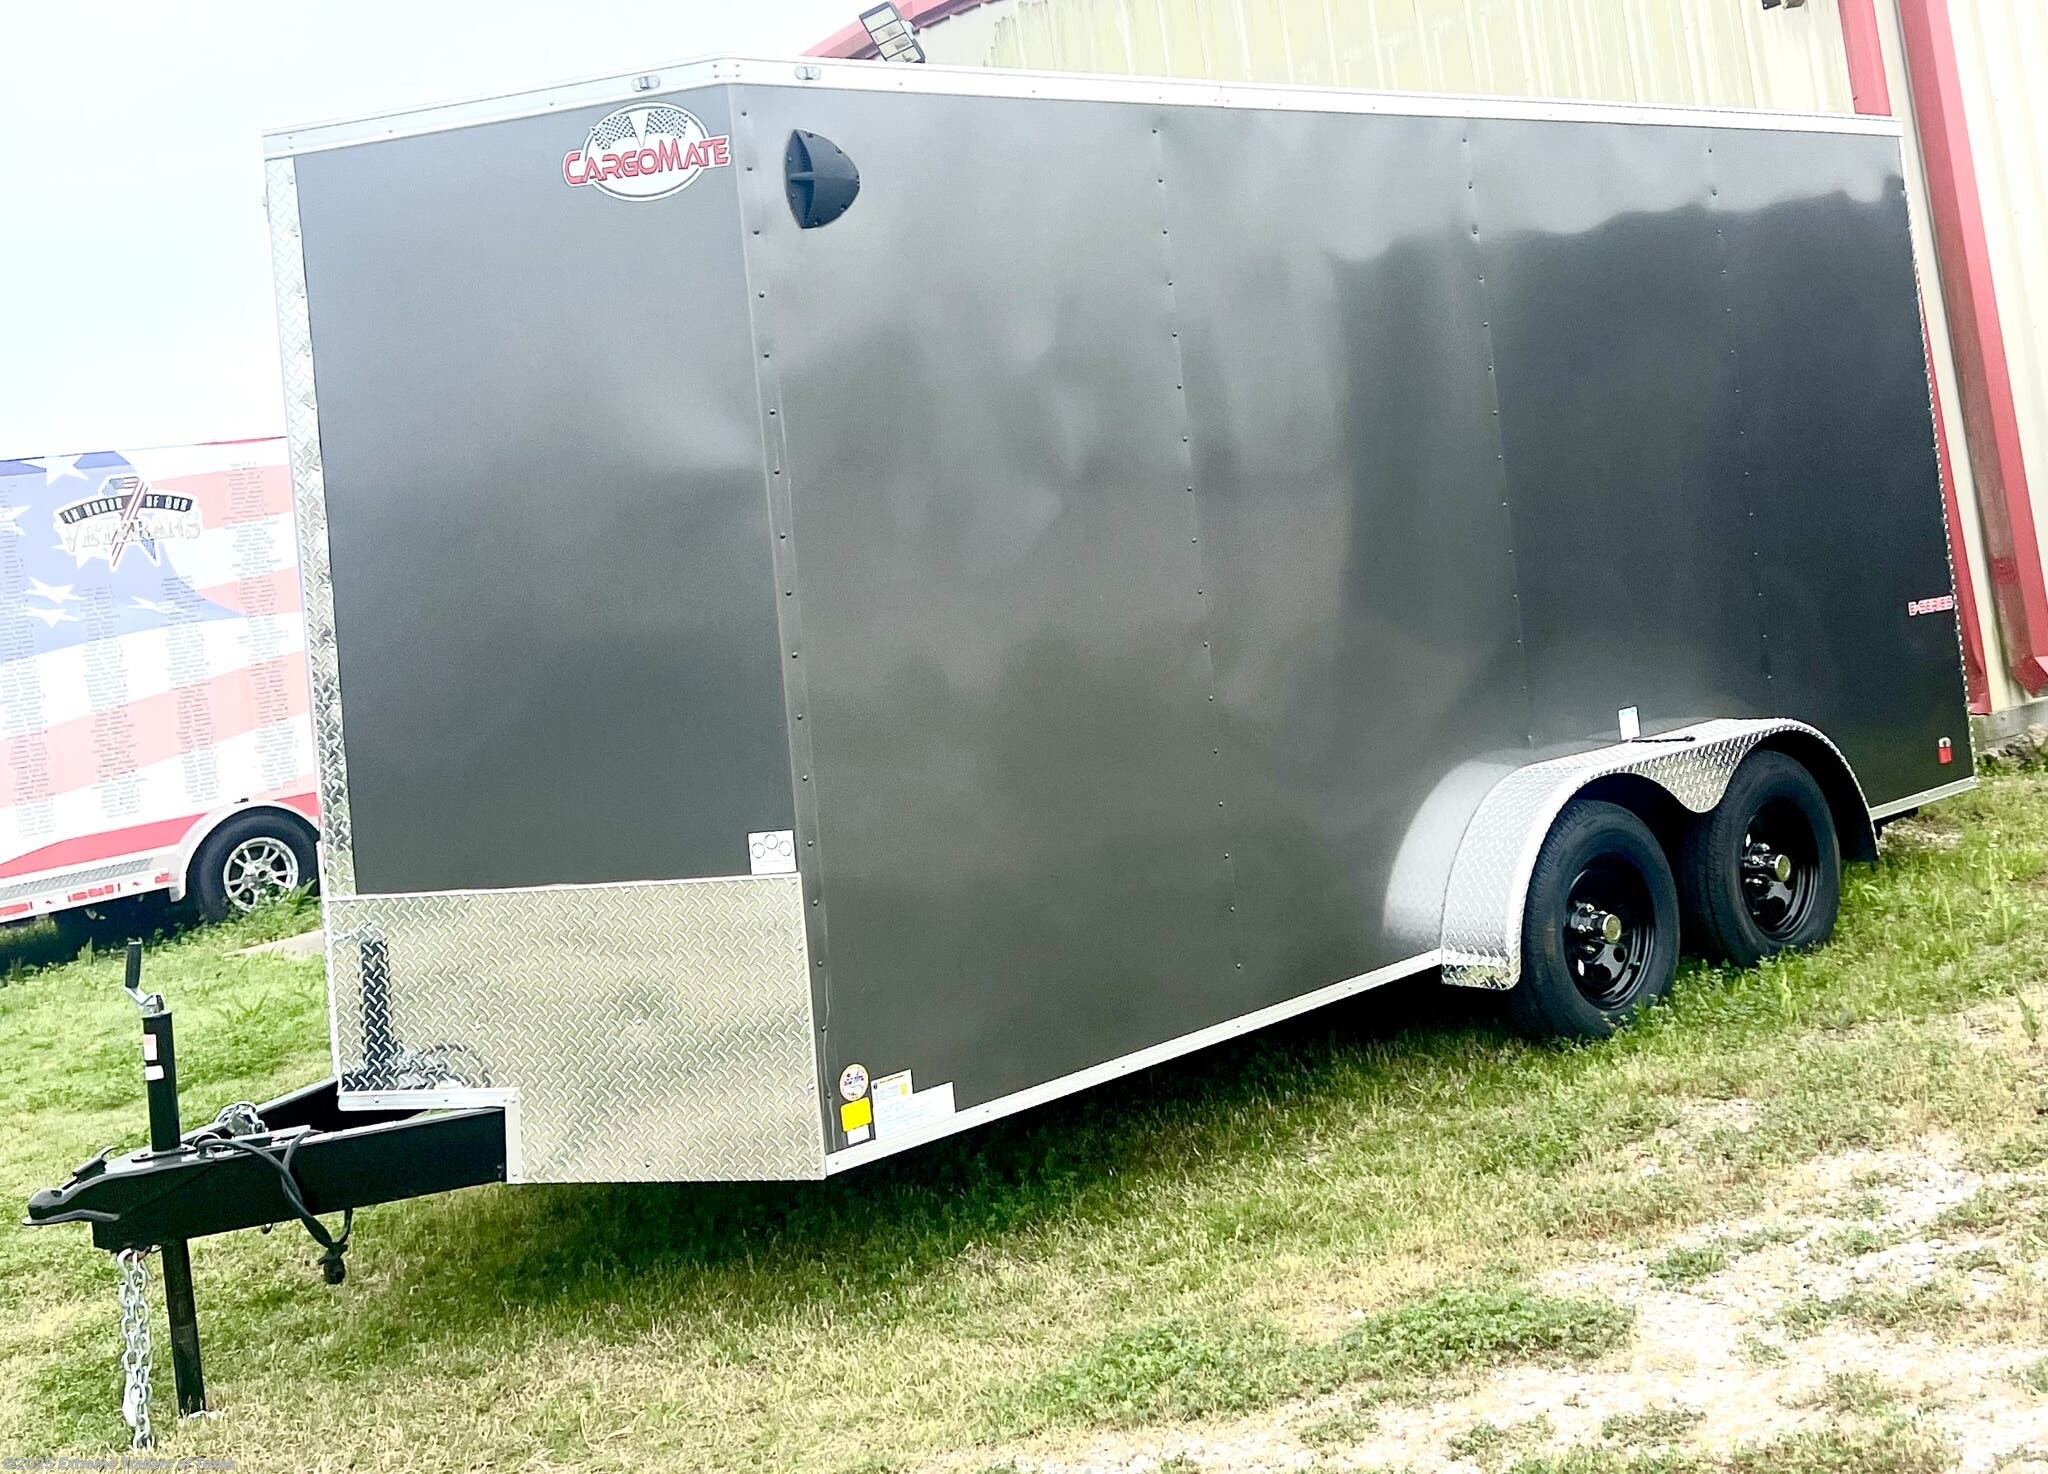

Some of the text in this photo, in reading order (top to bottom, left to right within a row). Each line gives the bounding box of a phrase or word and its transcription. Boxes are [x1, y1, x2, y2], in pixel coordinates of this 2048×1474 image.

[82, 497, 123, 518] HONOR
[146, 495, 160, 508] OF
[164, 495, 189, 511] OUR
